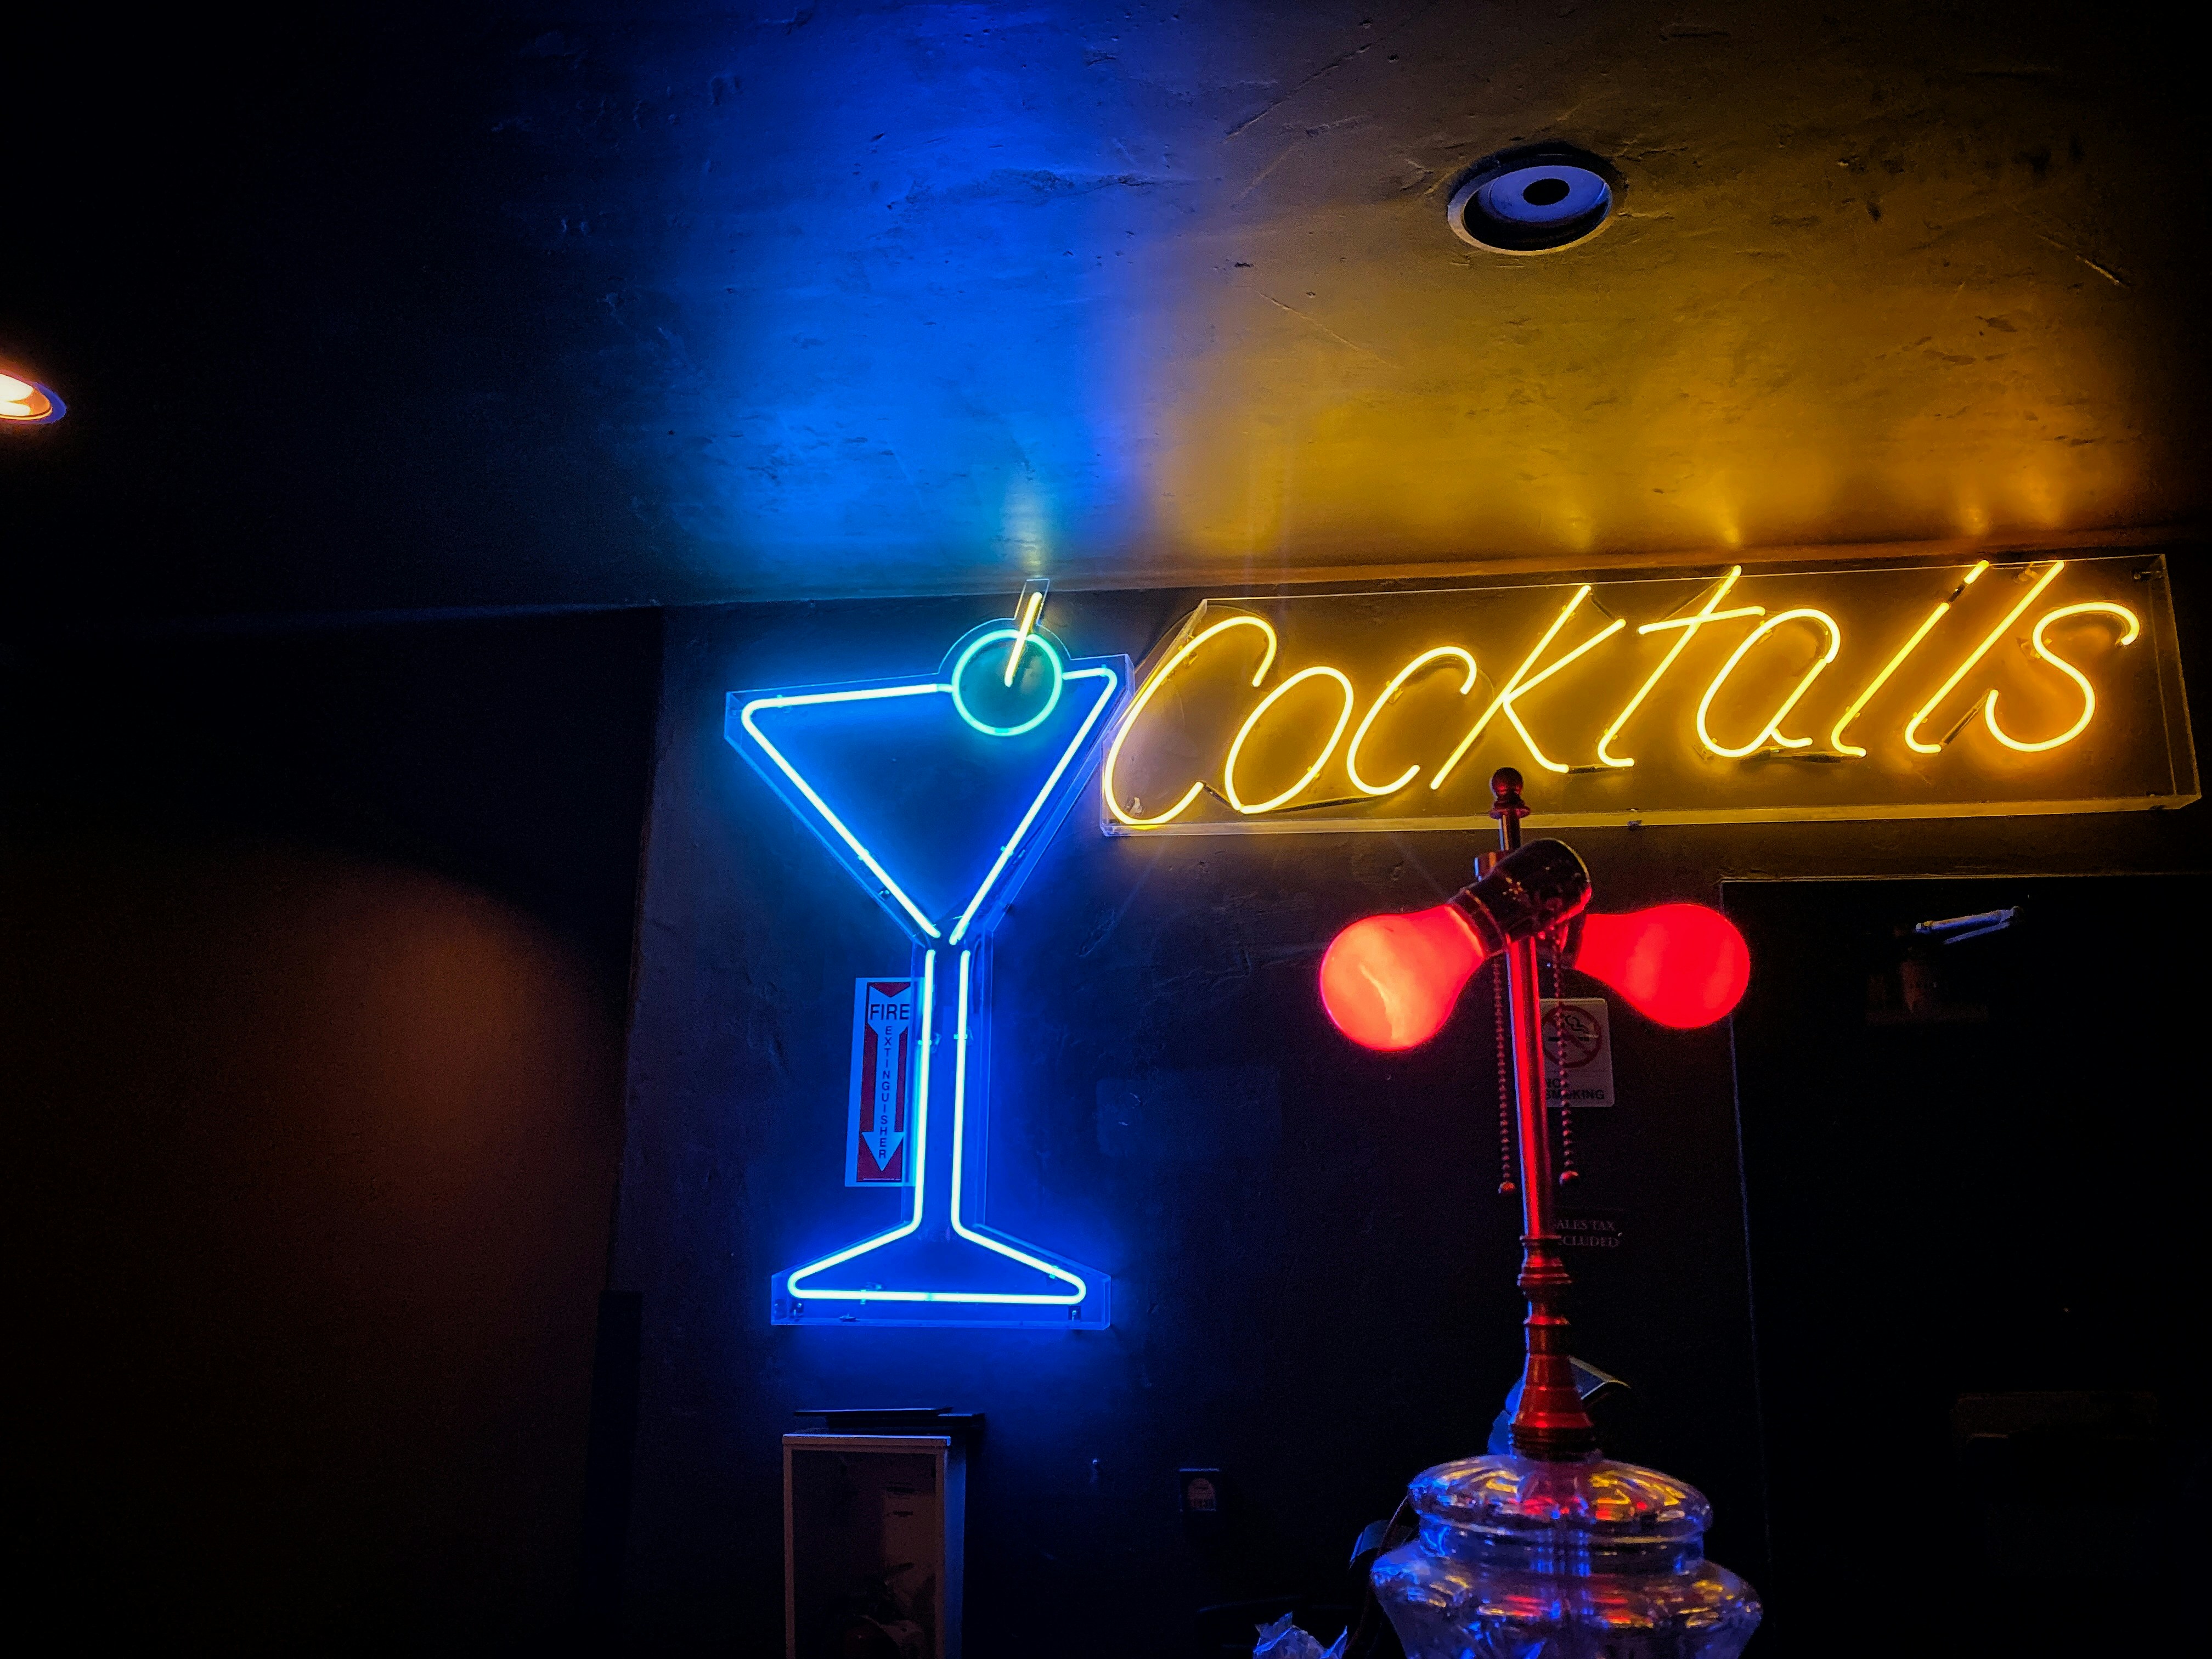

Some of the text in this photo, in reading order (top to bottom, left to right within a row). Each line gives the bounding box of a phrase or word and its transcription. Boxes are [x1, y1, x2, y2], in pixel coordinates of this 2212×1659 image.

[1102, 559, 2140, 826] Cocktails
[869, 1003, 910, 1020] FIRE
[878, 1025, 892, 1159] EXTINGUISHER
[1554, 1219, 1616, 1232] ALES TAX
[1558, 1235, 1620, 1248] CLUDED
